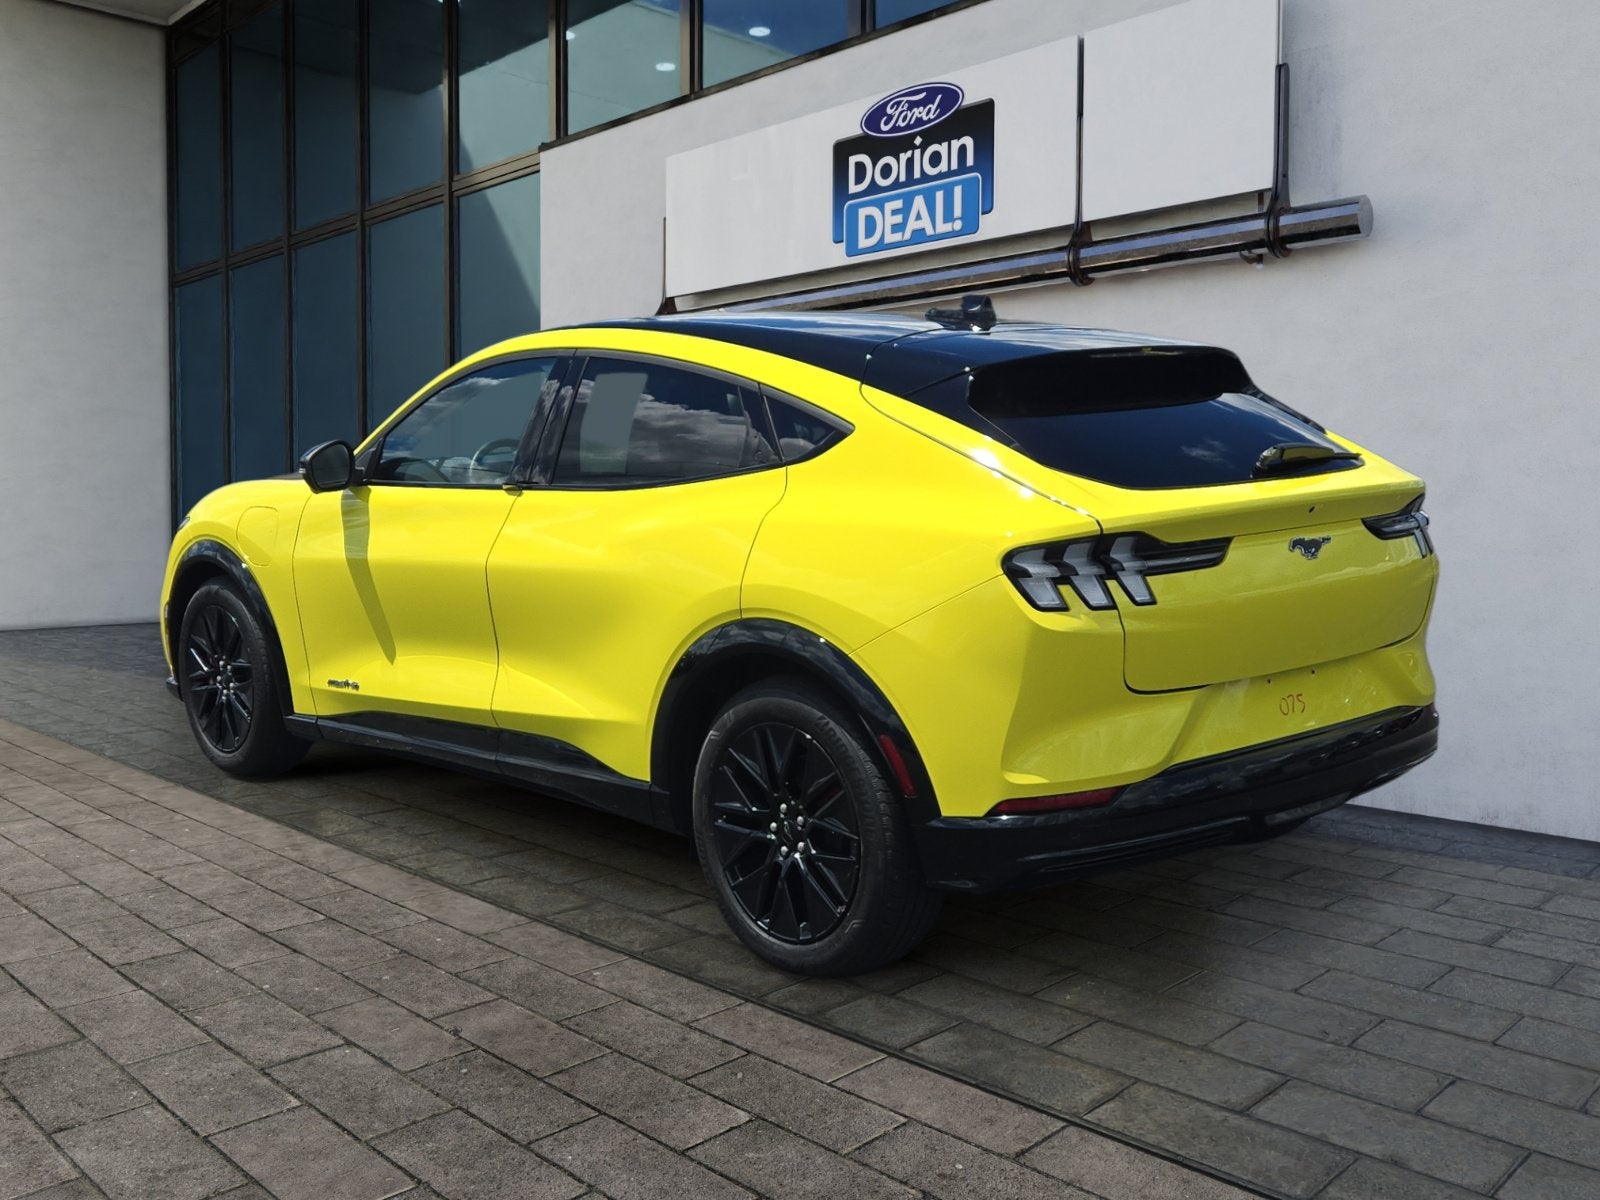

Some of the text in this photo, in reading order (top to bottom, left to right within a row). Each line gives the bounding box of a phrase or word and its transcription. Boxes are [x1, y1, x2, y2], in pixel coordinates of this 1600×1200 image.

[880, 91, 942, 132] Ford
[848, 135, 975, 194] Dorian
[858, 184, 963, 249] DEAL!
[1279, 693, 1306, 716] 075
